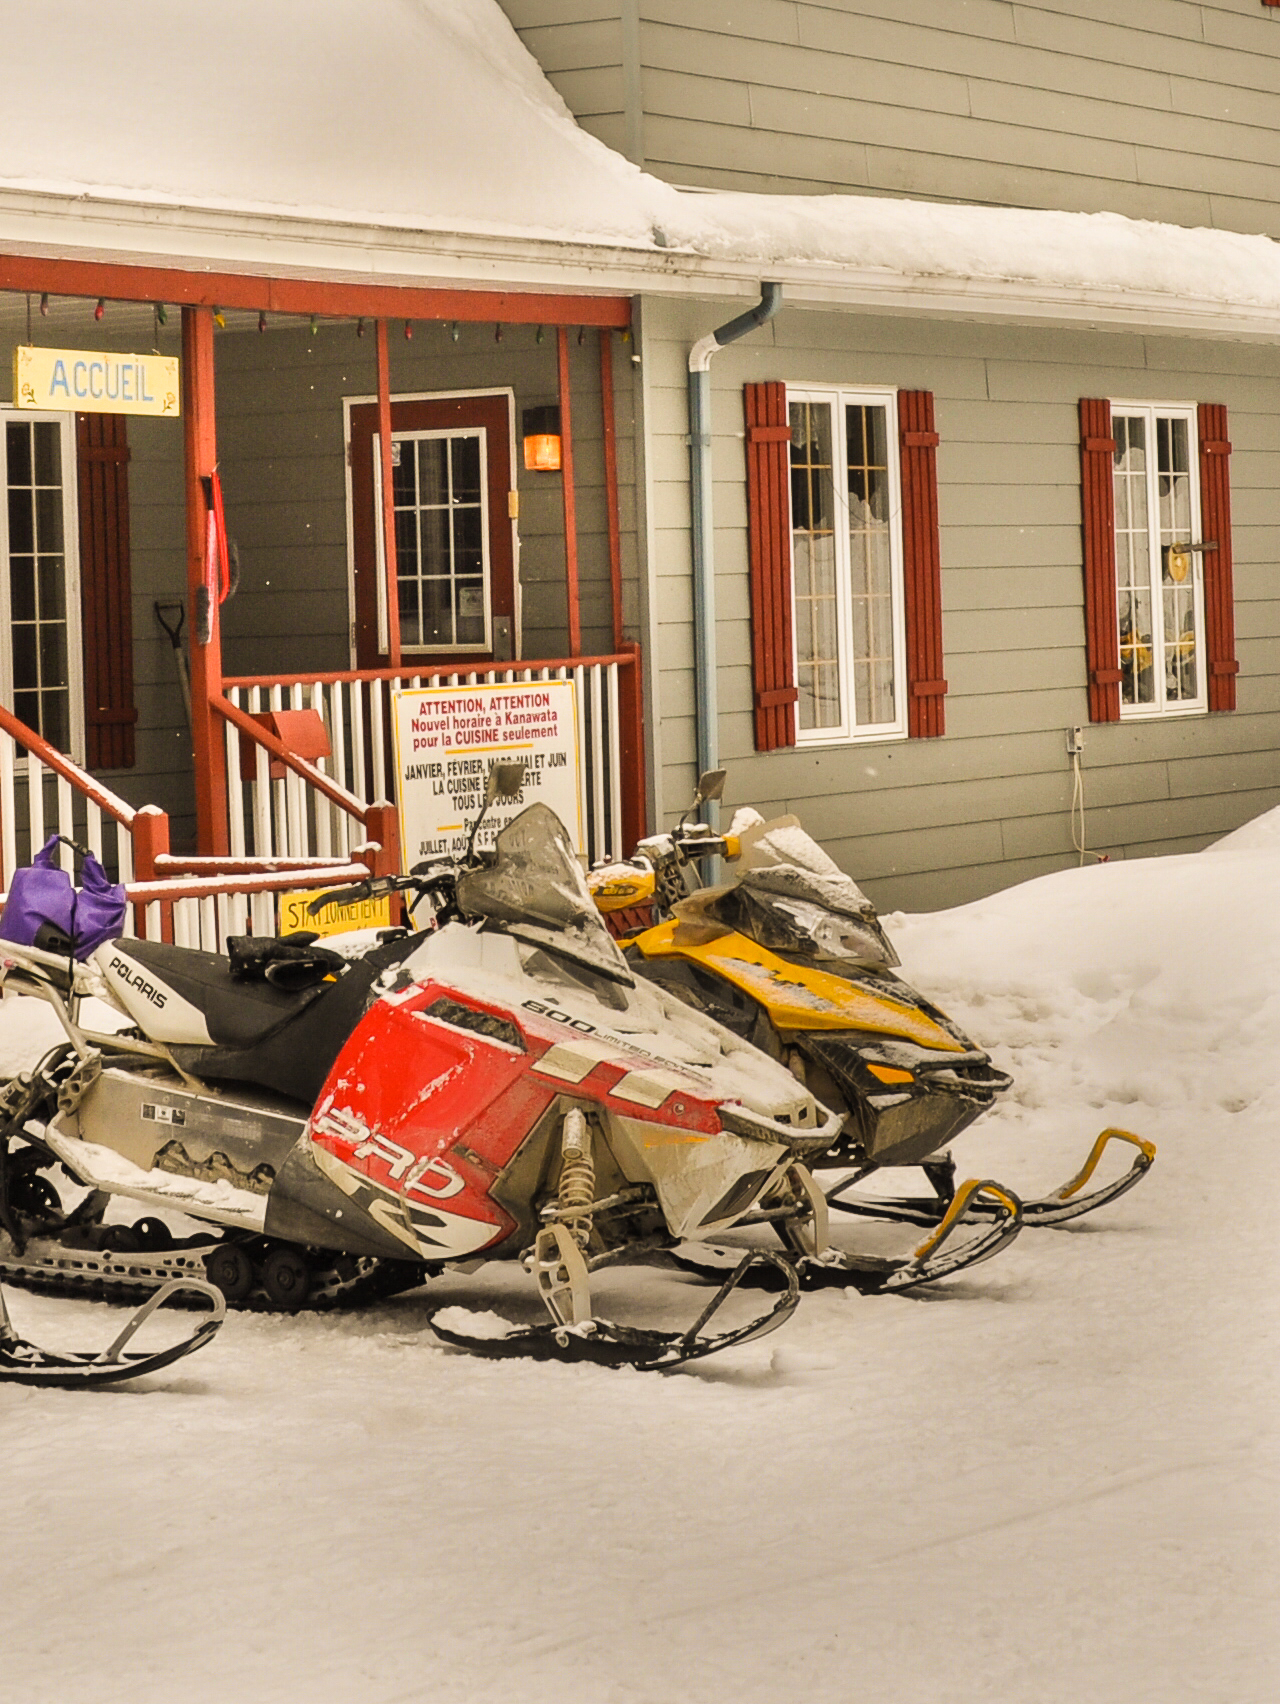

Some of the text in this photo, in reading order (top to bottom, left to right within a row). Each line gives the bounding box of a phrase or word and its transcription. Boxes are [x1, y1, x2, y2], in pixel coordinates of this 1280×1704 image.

[48, 359, 154, 402] ACCUEIL
[419, 693, 551, 716] ATTENTION, ATTENTION
[411, 709, 558, 733] Nouvel horaire à Kanawata
[413, 724, 558, 752] pour la CUISINE seulement
[404, 763, 446, 781] JANVIER,
[447, 759, 486, 777] FÉVRIER,
[535, 754, 545, 768] ET
[548, 752, 567, 767] JUIN
[433, 780, 444, 796] LA
[447, 776, 481, 794] CUISINE
[452, 795, 475, 811] TOUS
[419, 839, 451, 856] JUILLET,
[109, 956, 168, 1009] POLARIS
[521, 1000, 596, 1033] 800
[593, 1031, 652, 1057] LIMITED
[313, 1107, 465, 1199] PRO
